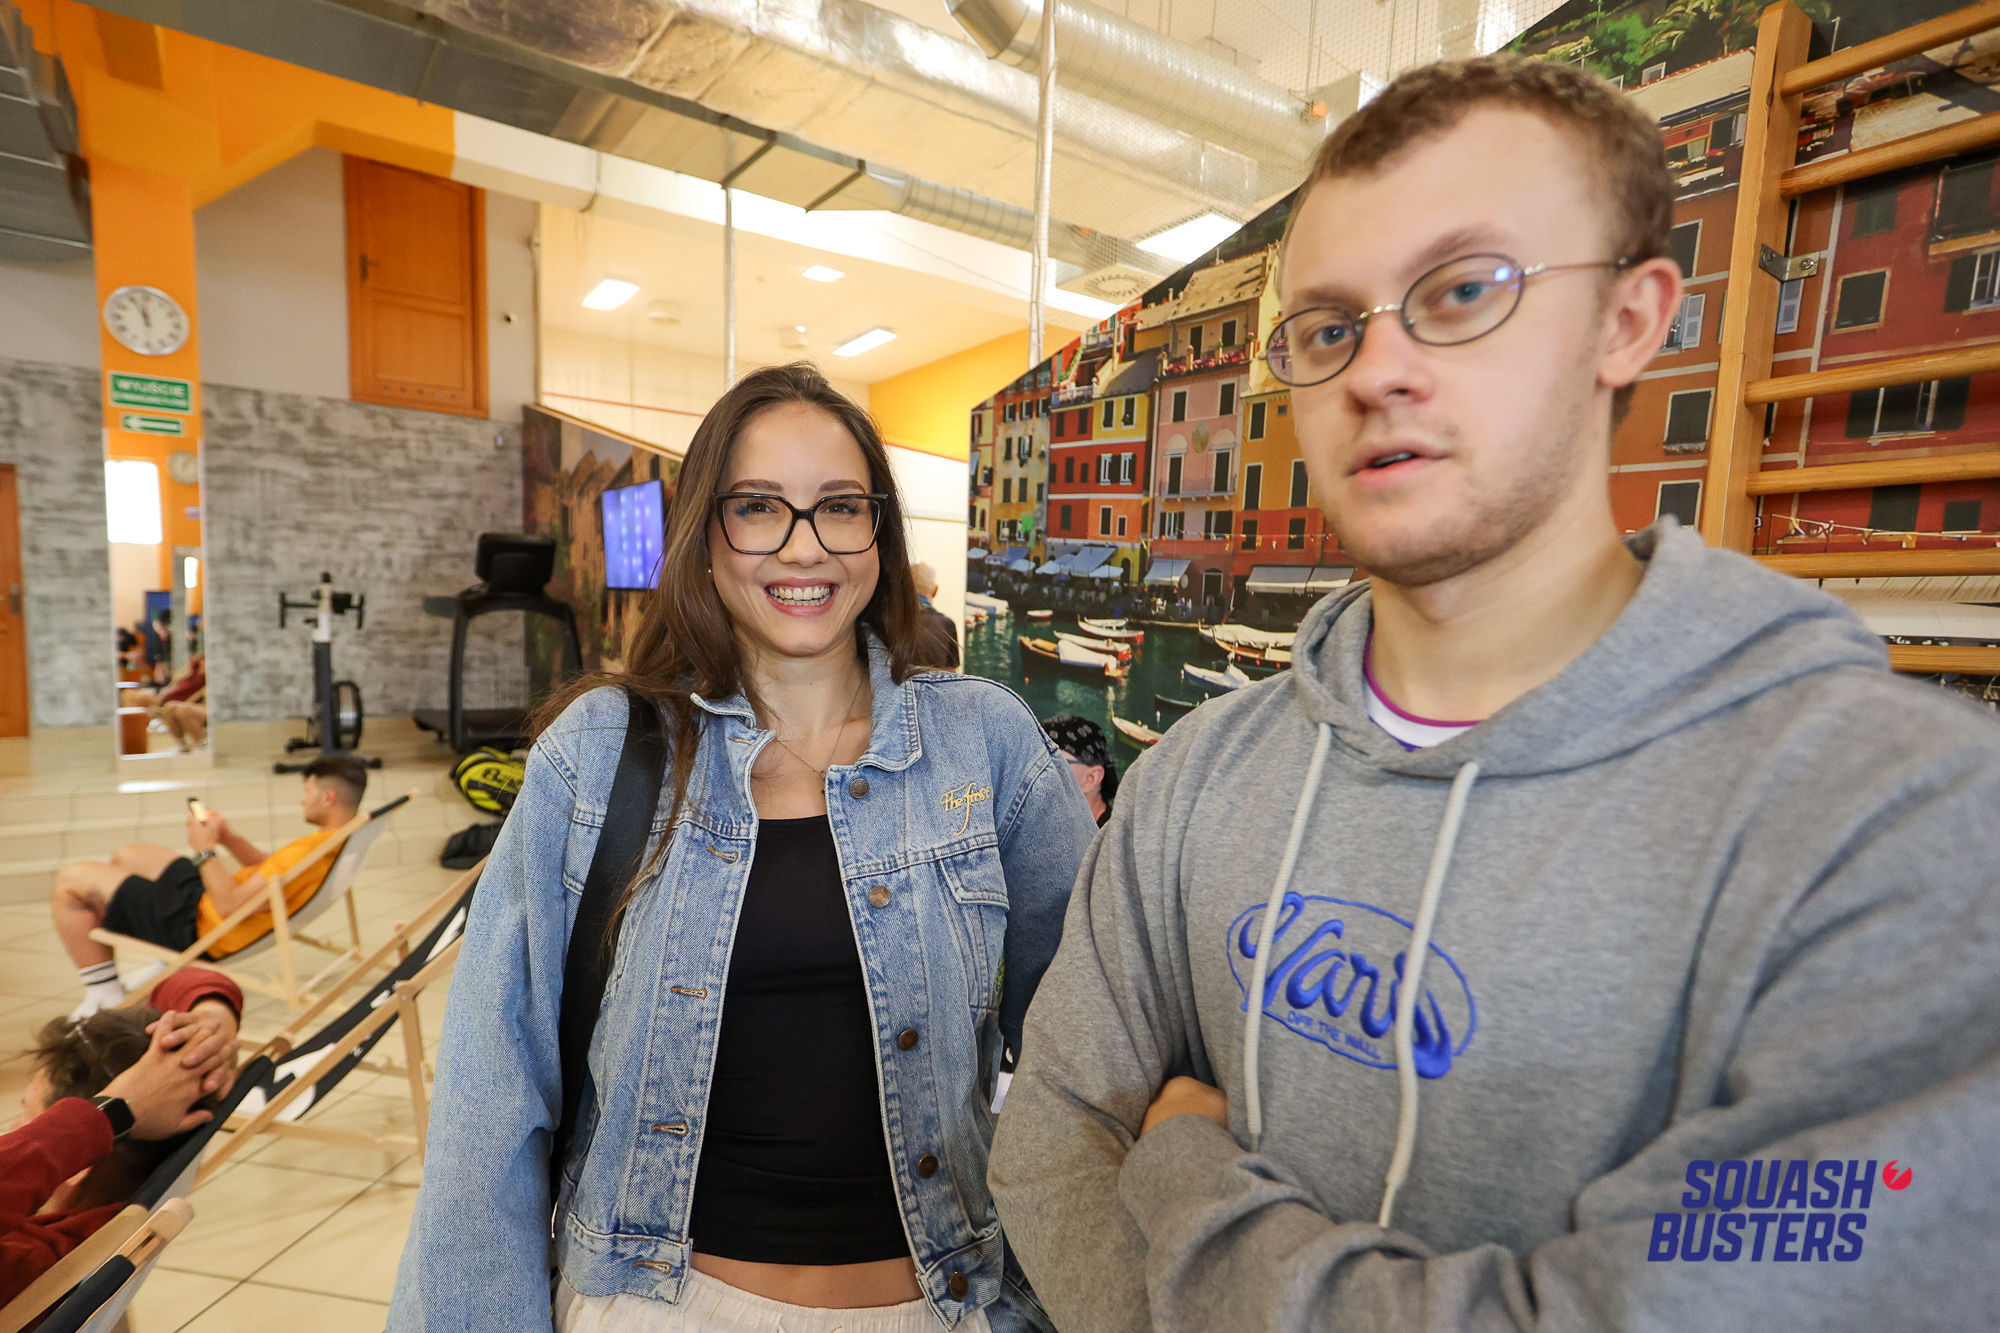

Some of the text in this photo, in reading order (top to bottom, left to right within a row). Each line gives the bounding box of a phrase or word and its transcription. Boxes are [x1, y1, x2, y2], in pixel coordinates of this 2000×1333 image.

[1287, 1010, 1381, 1060] OFF THE WALL
